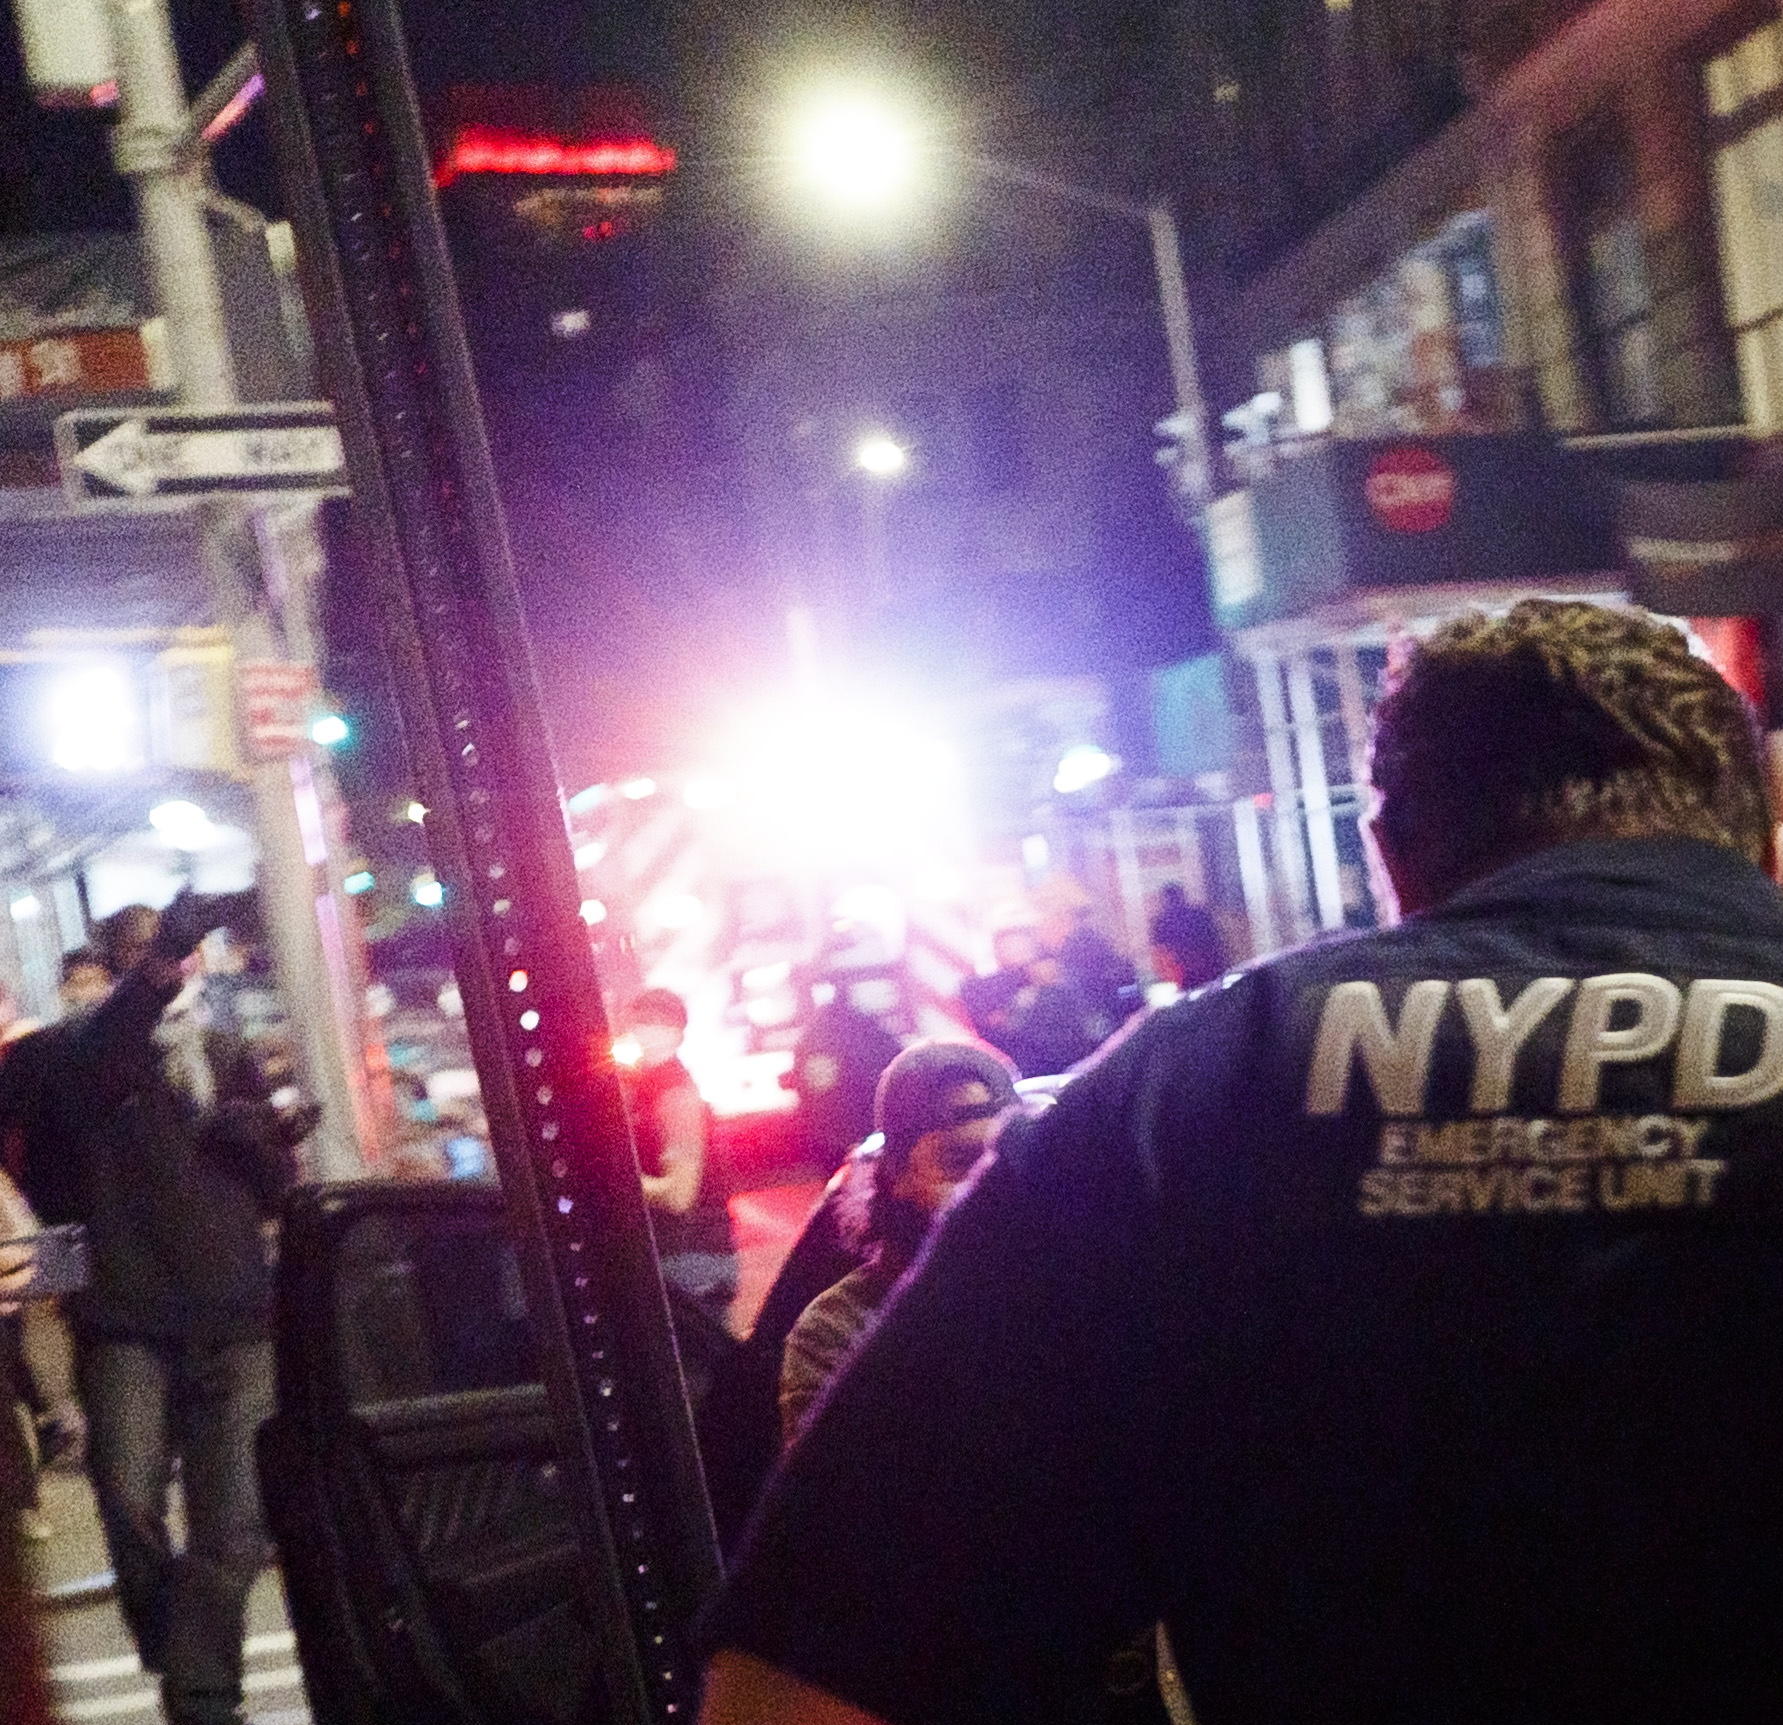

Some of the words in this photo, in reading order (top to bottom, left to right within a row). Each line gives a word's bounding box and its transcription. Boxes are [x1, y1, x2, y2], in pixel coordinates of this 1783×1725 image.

[1378, 1114, 1709, 1165] EMERGENCY
[1361, 1164, 1588, 1217] SERVICE
[1601, 1158, 1728, 1208] UNIT
